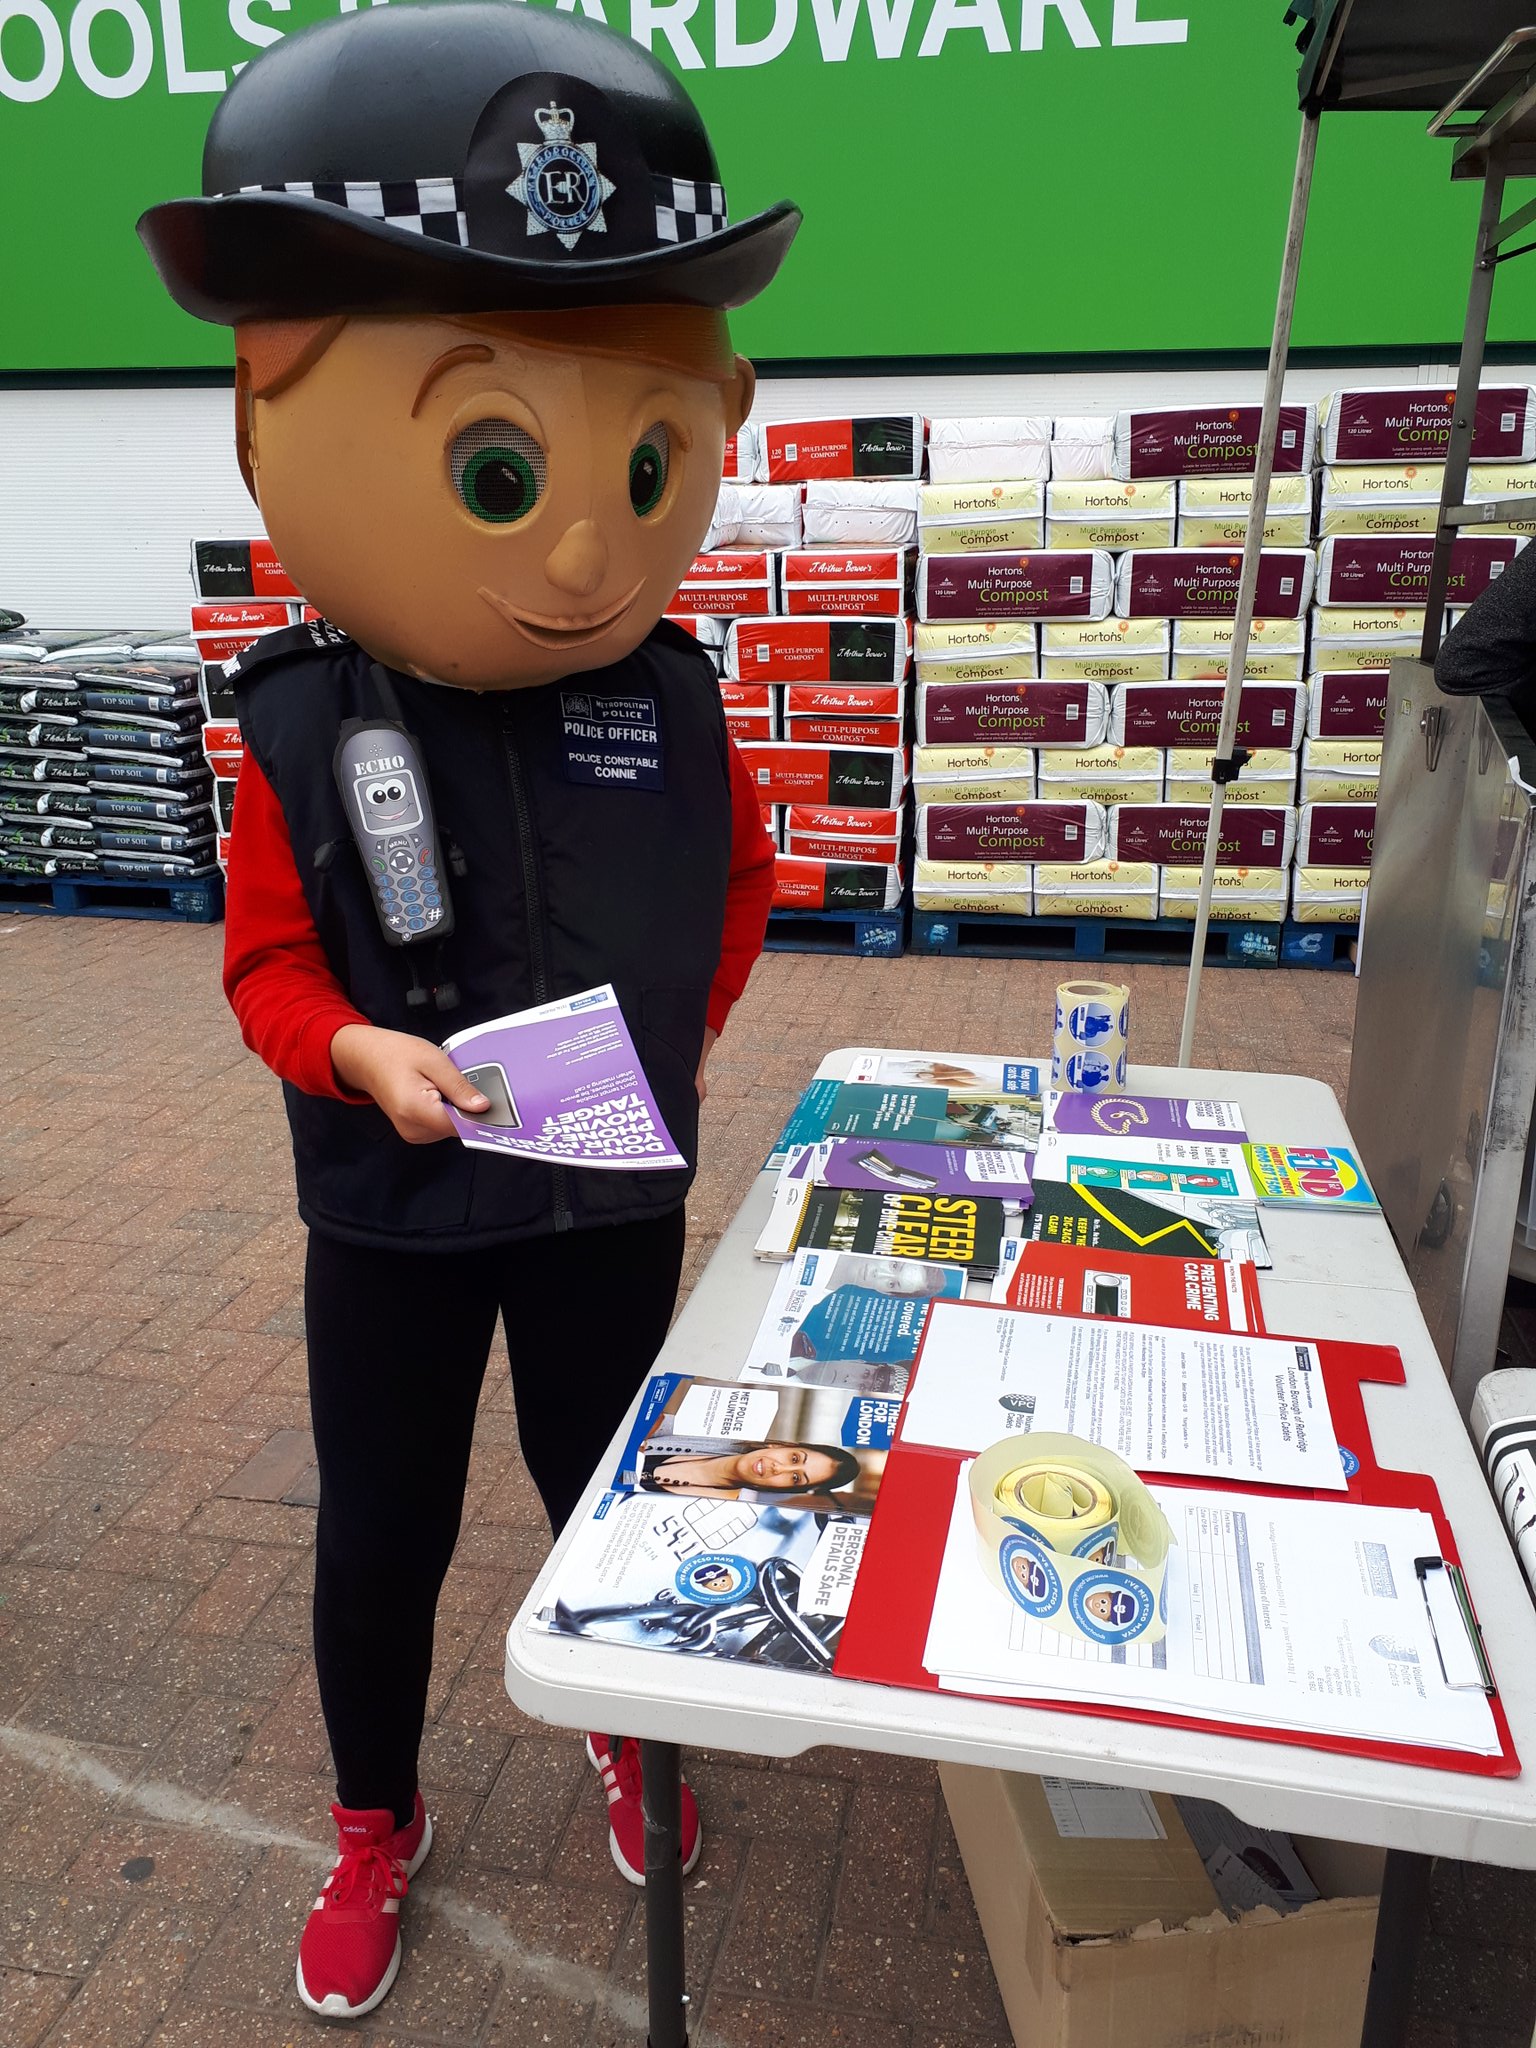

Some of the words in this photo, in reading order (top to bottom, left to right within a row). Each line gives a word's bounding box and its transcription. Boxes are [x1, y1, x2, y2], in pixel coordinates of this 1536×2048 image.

[543, 209, 588, 228] POLICE
[1409, 403, 1448, 413] Hortons
[1196, 421, 1232, 430] Hortons
[1385, 417, 1414, 428] Multi
[1174, 435, 1200, 445] Multi
[1203, 434, 1242, 444] Purpose
[801, 444, 848, 452] MULTI-PURPOSE
[886, 442, 906, 452] Bower's
[1187, 444, 1258, 460] Compost
[1363, 478, 1409, 489] Hortons
[954, 498, 996, 510] Hortons
[1085, 496, 1128, 506] Hortons
[1366, 518, 1419, 530] Compost
[960, 533, 1009, 545] Compost
[1089, 532, 1138, 544] Compost
[845, 561, 872, 572] Bower's
[988, 566, 1023, 576] Hortons
[968, 579, 992, 589] Multi
[995, 579, 1032, 590] Purpose
[808, 594, 879, 602] MULTI-PURPOSE
[980, 588, 1048, 604] Compost
[821, 602, 865, 610] COMPOST
[241, 611, 264, 622] Bower's
[117, 698, 136, 706] SOIL
[596, 700, 649, 710] METROPOLITAN
[986, 694, 1020, 703] Hortons
[602, 710, 642, 719] POLICE
[966, 706, 989, 714] Multi
[992, 706, 1029, 716] Purpose
[978, 714, 1046, 730] Compost
[564, 722, 604, 739] POLICE
[608, 727, 658, 743] OFFICER
[810, 725, 880, 735] MULTI-PURPOSE
[823, 734, 865, 742] COMPOST
[353, 755, 406, 776] ECHO
[568, 752, 602, 764] POLICE
[604, 755, 658, 769] CONSTABLE
[595, 766, 637, 780] CONNIE
[132, 838, 148, 846] SOIL
[389, 840, 408, 849] MENU
[615, 1074, 636, 1085] phone
[616, 1070, 634, 1078] when
[1008, 1066, 1017, 1080] cards
[1016, 1068, 1032, 1080] Keep
[591, 1076, 615, 1087] making
[620, 1080, 638, 1090] Don't
[1006, 1080, 1019, 1090] safe
[1018, 1080, 1030, 1090] your
[599, 1084, 620, 1096] tempt
[560, 1094, 580, 1103] aware
[576, 1094, 599, 1103] mobile
[542, 1092, 646, 1127] TARGET
[541, 1106, 650, 1134] MOVING
[560, 1118, 656, 1142] PHONE
[534, 1134, 554, 1142] A
[583, 1132, 662, 1148] YOUR
[580, 1141, 666, 1156] DON'T
[1176, 1145, 1186, 1158] caller
[1189, 1146, 1199, 1160] bogus
[1205, 1147, 1215, 1157] beat
[1219, 1148, 1228, 1158] How
[1207, 1158, 1216, 1166] the
[1268, 1146, 1284, 1166] FAMILIES
[1280, 1178, 1296, 1195] DIRECT
[883, 1194, 902, 1208] OF
[879, 1208, 899, 1228] BIKE
[1034, 1214, 1043, 1222] IT'S
[1048, 1215, 1059, 1235] CLEAR!
[1077, 1217, 1088, 1233] KEEP
[889, 1195, 932, 1256] CLEAR
[928, 1198, 977, 1261] STEER
[1033, 1222, 1042, 1230] THE
[1061, 1216, 1074, 1244] ZIG-ZAGS
[873, 1230, 895, 1255] CRIME
[1076, 1235, 1087, 1246] THE
[1184, 1262, 1199, 1281] CAR
[1185, 1282, 1202, 1310] CRIME
[1200, 1264, 1220, 1320] PREVENTING
[897, 1301, 916, 1337] covered.
[1287, 1367, 1298, 1389] London
[1275, 1374, 1286, 1402] Volunteer
[740, 1391, 750, 1405] MET
[1010, 1400, 1034, 1408] VPC
[1290, 1390, 1302, 1415] Borough
[721, 1391, 740, 1435] VOLUNTEERS
[873, 1401, 888, 1423] FOR
[1279, 1402, 1290, 1420] Police
[732, 1407, 747, 1431] POLICE
[856, 1400, 874, 1445] LONDON
[887, 1402, 902, 1436] THERE
[1006, 1413, 1015, 1428] Cadets
[1015, 1414, 1024, 1428] Police
[1281, 1421, 1292, 1442] Cadets
[1295, 1423, 1308, 1452] Redbridge
[824, 1526, 847, 1571] DETAILS
[836, 1528, 863, 1588] PERSONAL
[1037, 1552, 1048, 1568] I'VE
[1046, 1569, 1056, 1585] MET
[1256, 1562, 1269, 1596] Expression
[815, 1575, 834, 1606] SAFE
[1124, 1579, 1139, 1590] I'VE
[1050, 1585, 1059, 1606] PCSO
[1138, 1589, 1149, 1604] MET
[1035, 1603, 1051, 1614] MAYA
[1140, 1604, 1150, 1622] PCSO
[1262, 1604, 1273, 1630] Interest
[1122, 1622, 1143, 1638] MAYA
[1388, 1663, 1400, 1687] Cadets
[1399, 1664, 1412, 1686] Police
[1412, 1666, 1427, 1699] Volunteer
[343, 1825, 367, 1833] adidas
